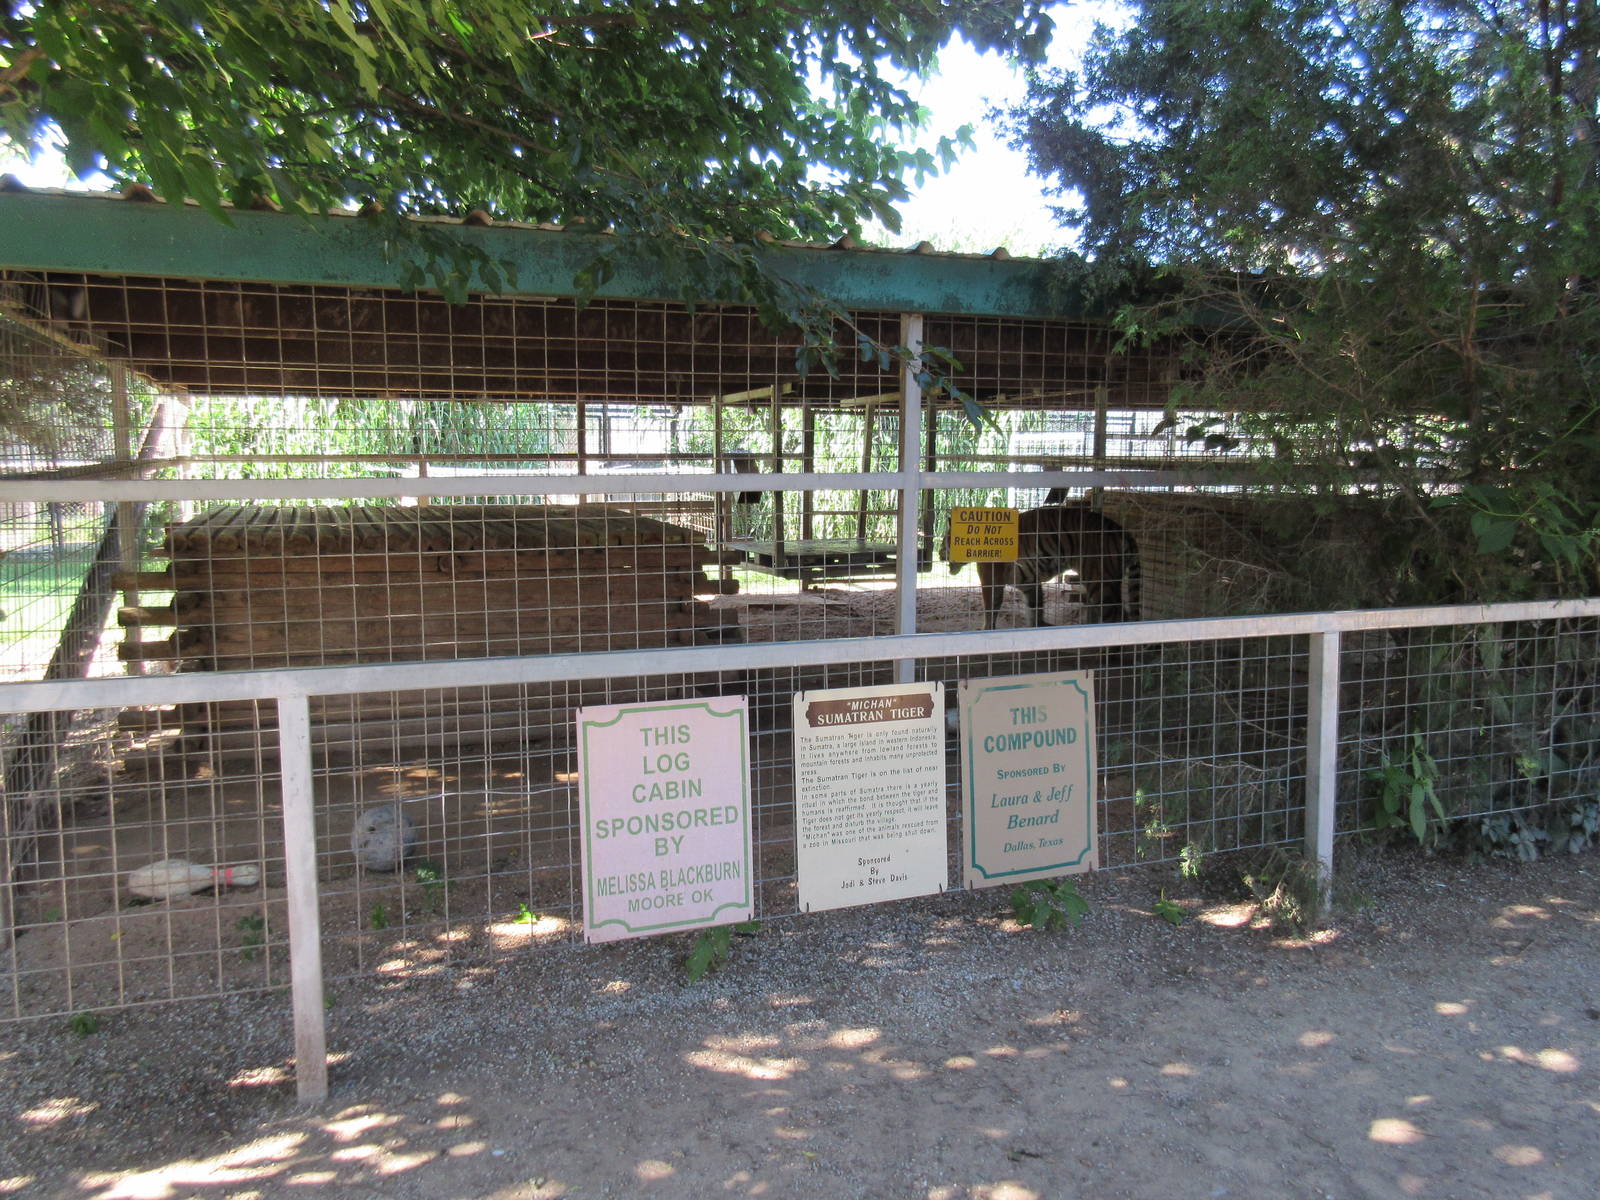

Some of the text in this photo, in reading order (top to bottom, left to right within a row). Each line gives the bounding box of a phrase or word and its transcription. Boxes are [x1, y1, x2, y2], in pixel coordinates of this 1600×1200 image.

[960, 511, 1011, 521] CAUTION
[954, 537, 1013, 546] REACH ACROSS
[847, 699, 896, 710] "MICHAN"
[818, 707, 925, 725] SUMATRAN TIGER
[1010, 705, 1048, 725] THIS
[640, 725, 691, 746] THIS
[984, 728, 1077, 753] COMPOUND
[643, 752, 690, 774] LOG
[997, 767, 1049, 780] SPONSORED
[632, 779, 701, 803] CABIN
[991, 784, 1073, 808] Laura & Jeff
[595, 806, 738, 839] SPONSORED
[1007, 810, 1059, 829] Benard
[656, 835, 684, 856] BY
[1039, 838, 1063, 848] Texas
[858, 854, 891, 866] Sponsored
[597, 860, 740, 896] MELISSA BLACKBURN
[868, 878, 886, 886] Steve
[891, 873, 907, 882] Davis
[871, 867, 879, 876] By
[629, 889, 713, 912] MOORE OK
